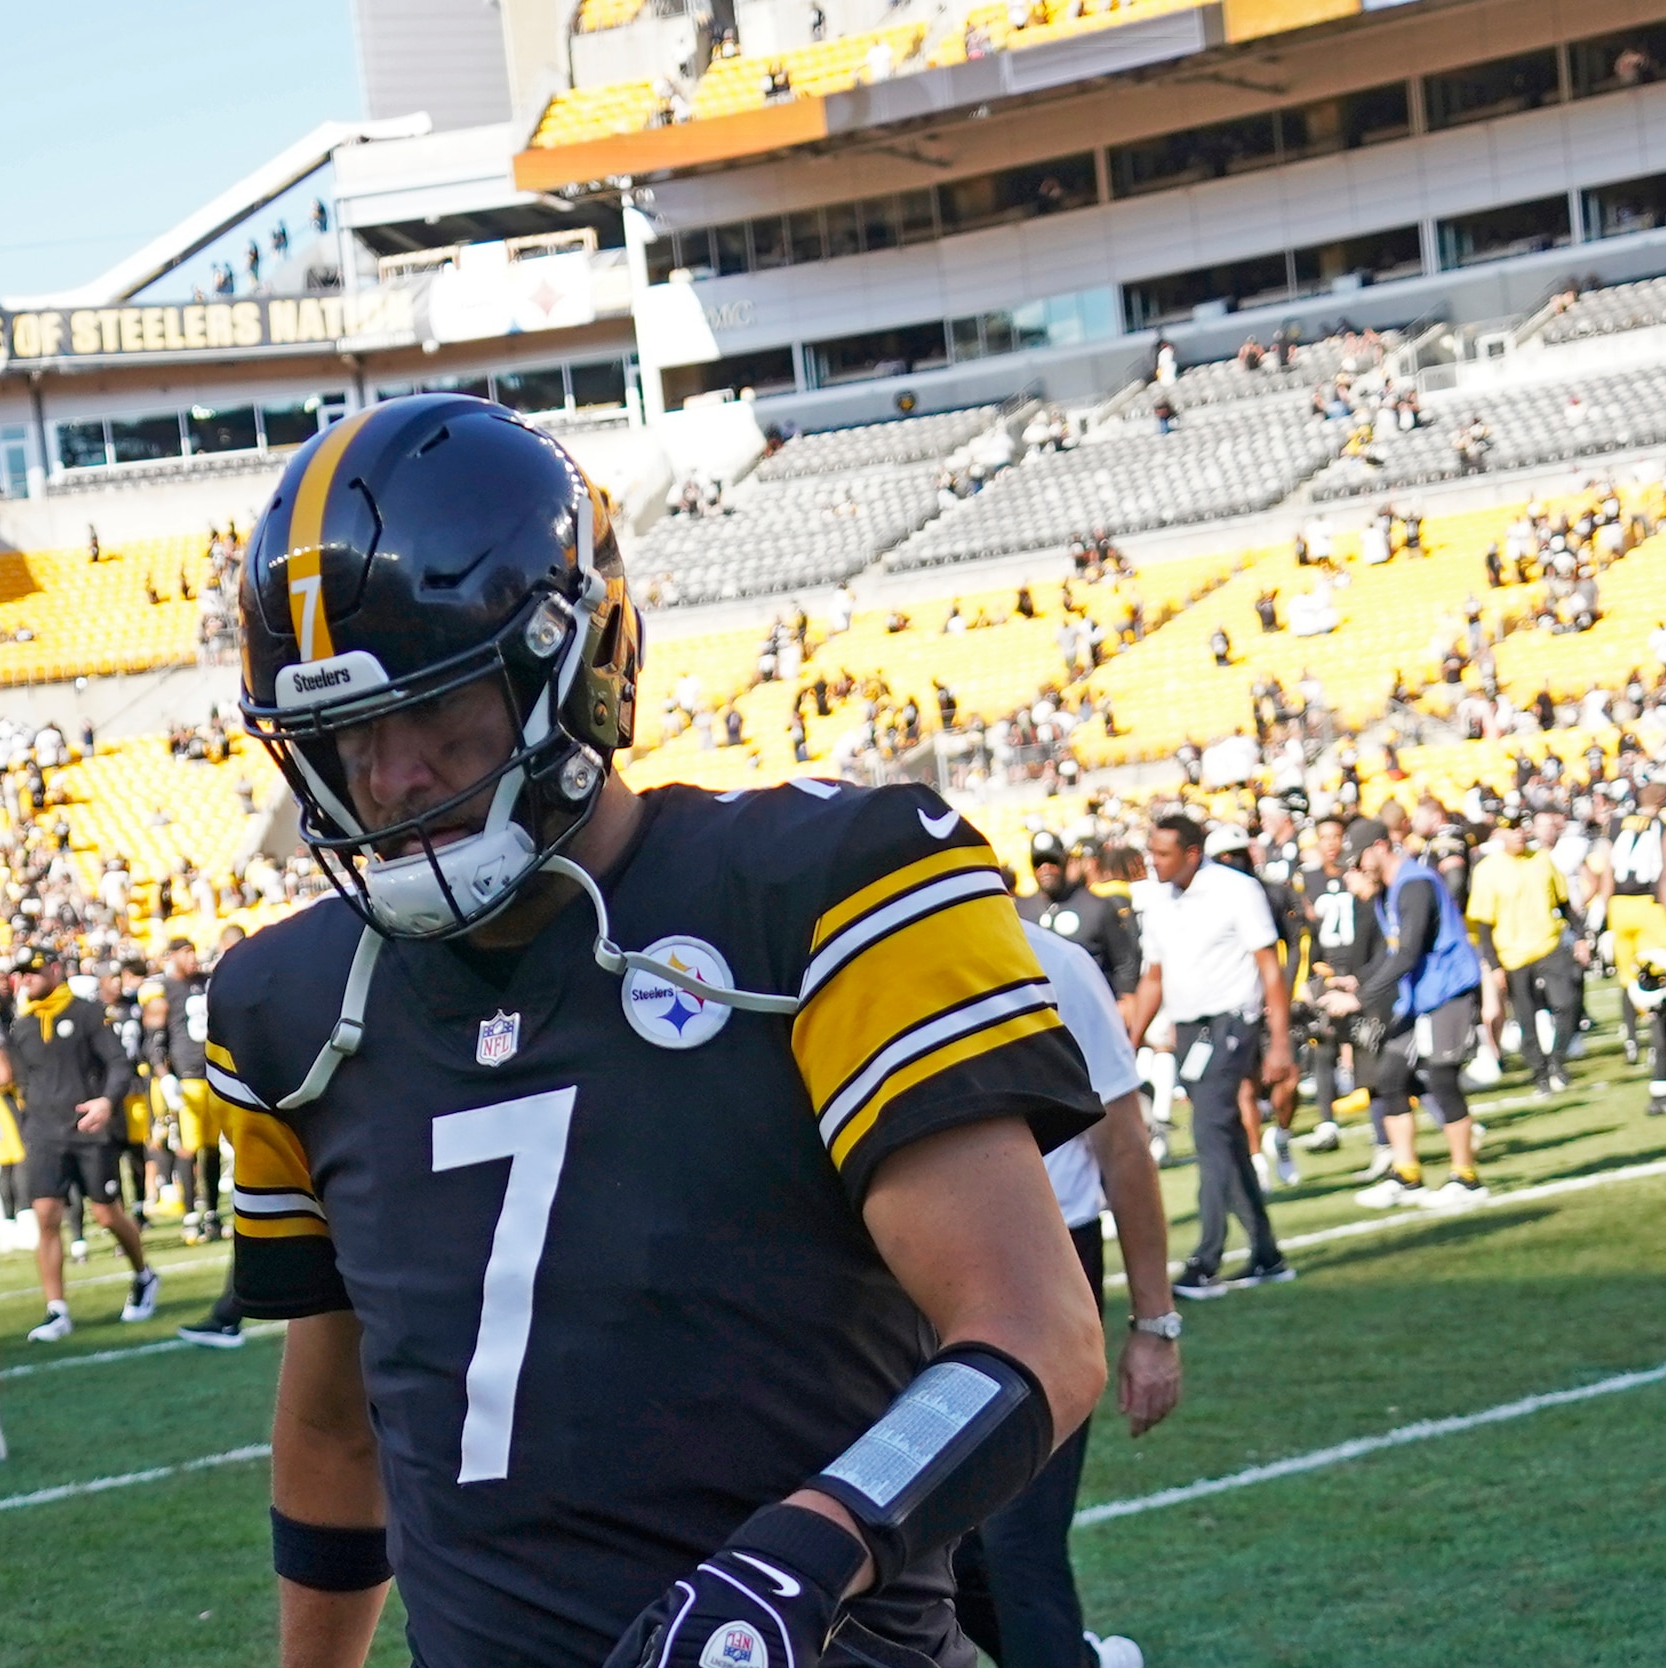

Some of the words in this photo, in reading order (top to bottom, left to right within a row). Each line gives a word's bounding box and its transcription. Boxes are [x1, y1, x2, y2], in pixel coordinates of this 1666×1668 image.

[13, 311, 63, 358] OF
[71, 302, 262, 354] STEELERS
[269, 289, 416, 343] NAT
[290, 575, 321, 663] 7
[293, 668, 351, 693] Steelers
[631, 986, 674, 1001] Steelers
[483, 1036, 509, 1056] NFL
[432, 1085, 578, 1484] 7
[727, 1630, 751, 1651] NFL
